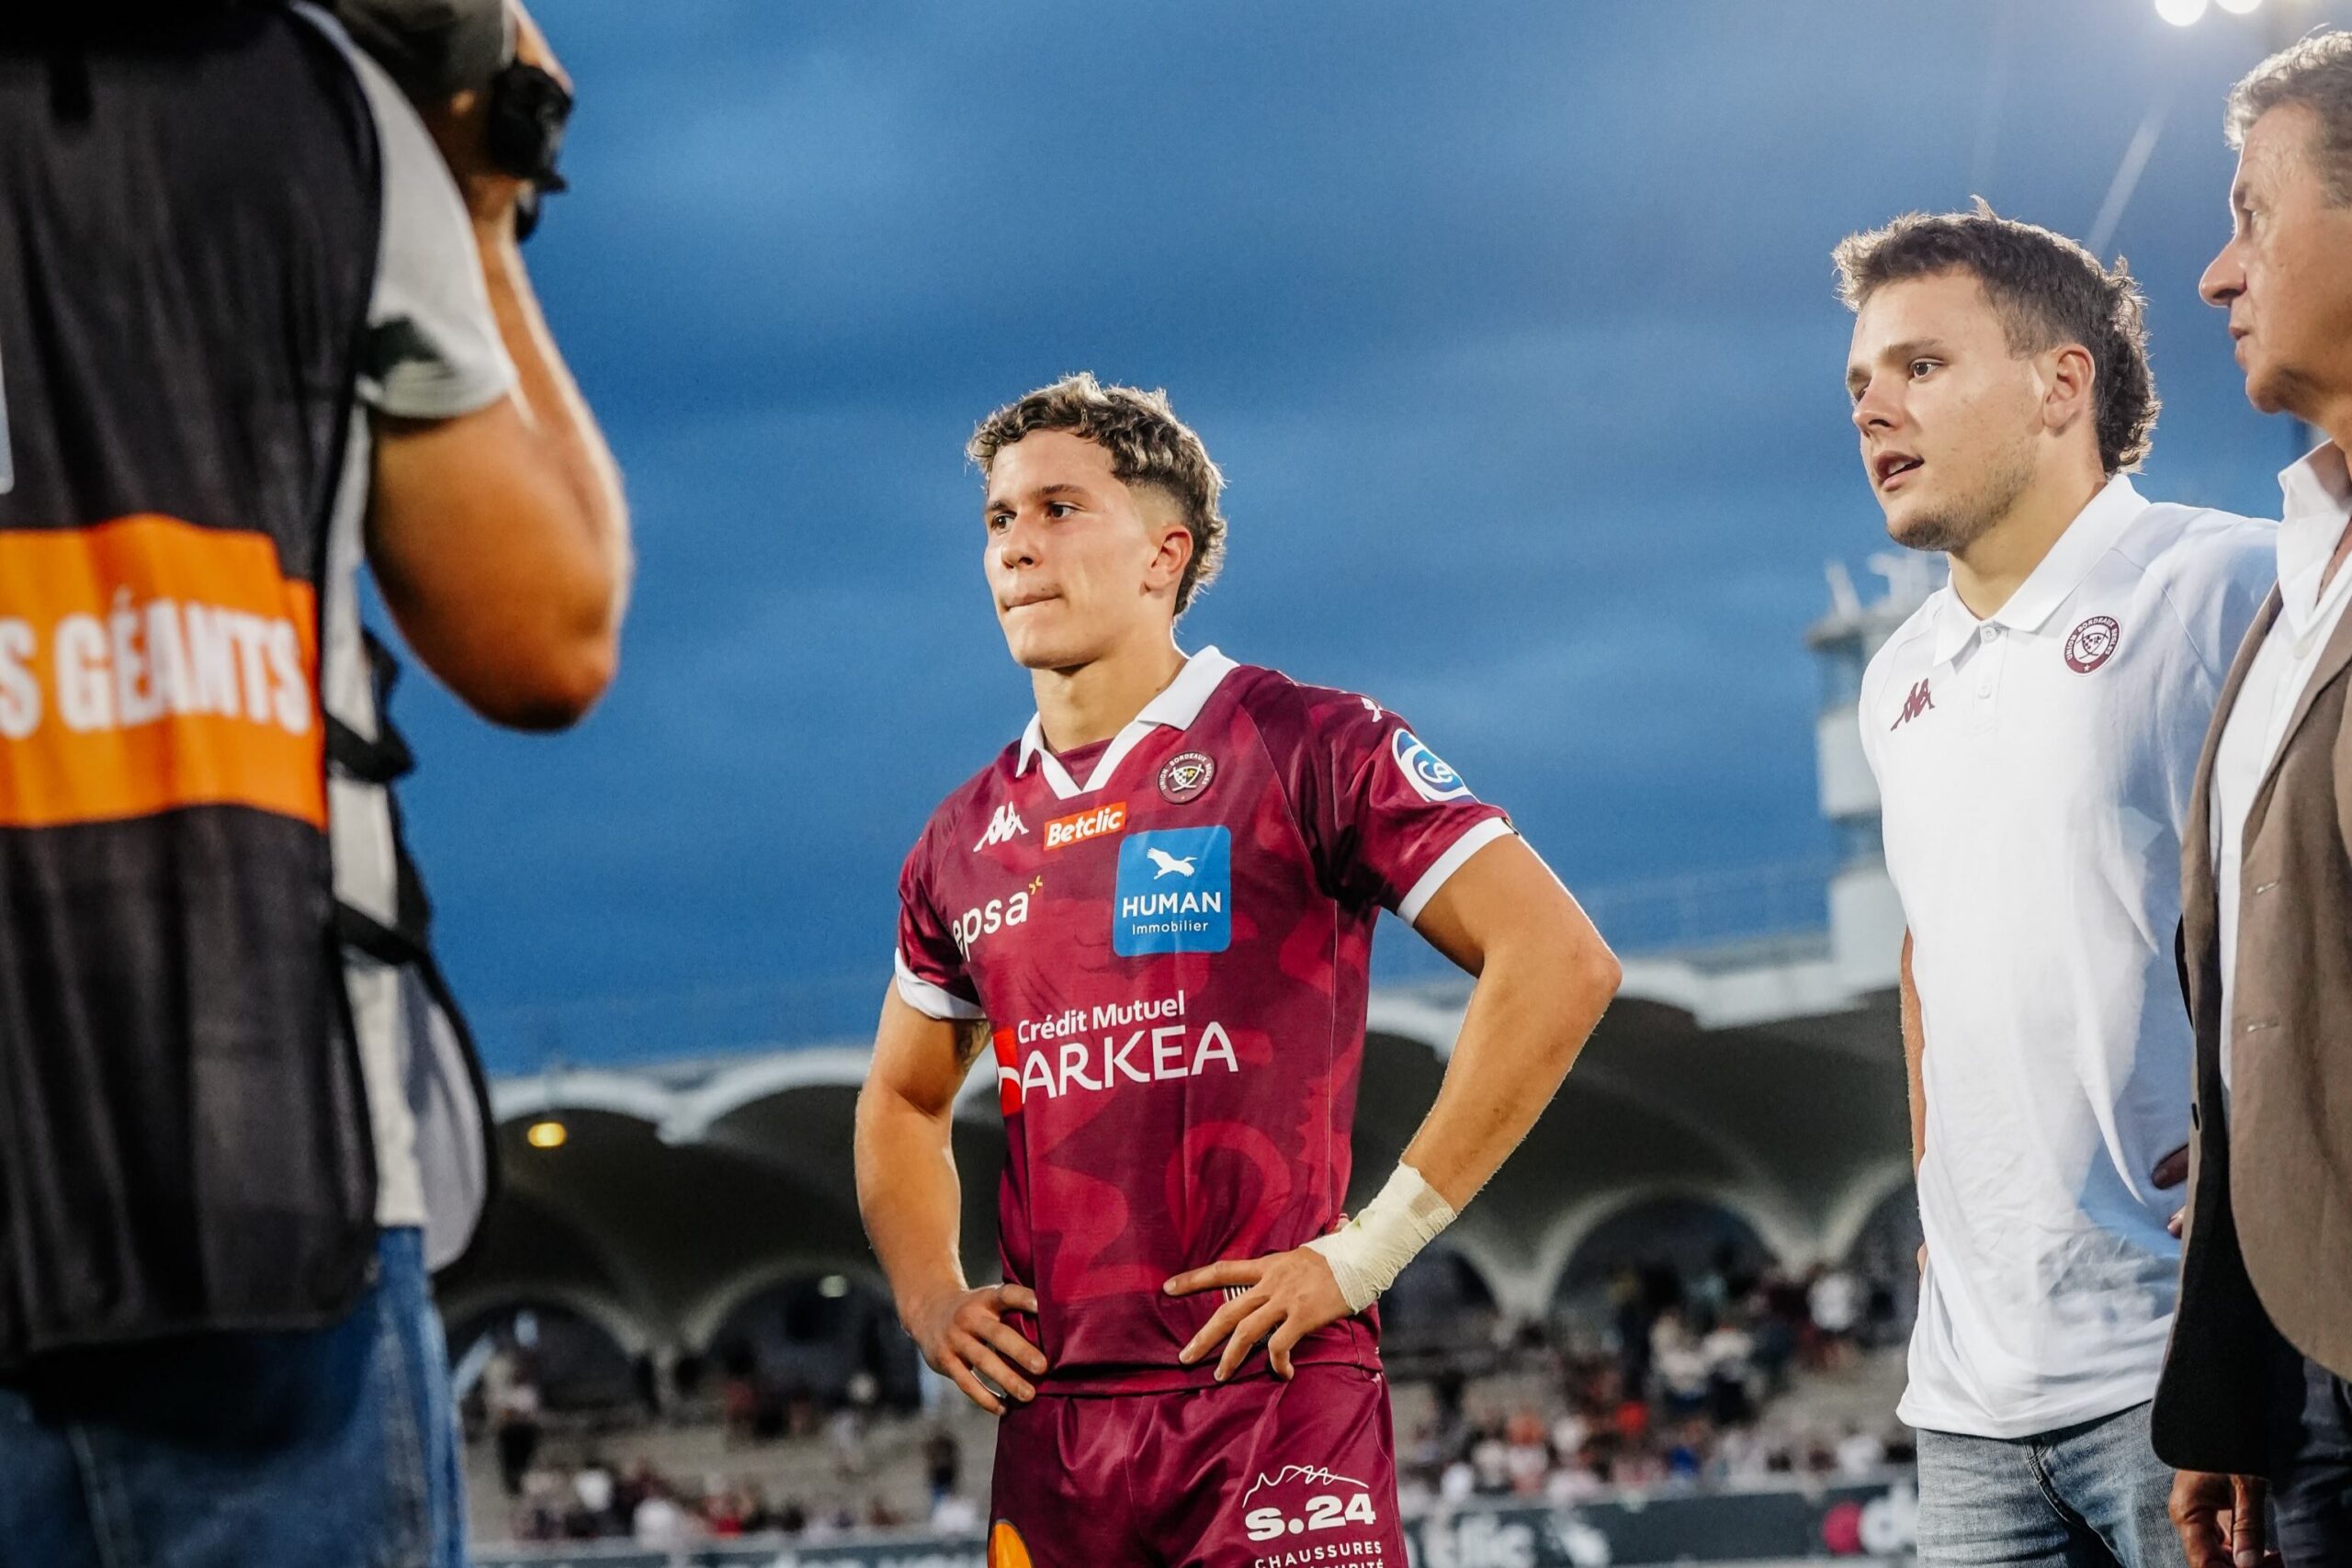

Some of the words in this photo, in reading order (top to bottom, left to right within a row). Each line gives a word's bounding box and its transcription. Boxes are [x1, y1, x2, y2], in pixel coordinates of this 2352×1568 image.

[2066, 635, 2077, 660] UNION
[2077, 617, 2116, 633] BORDEAUX
[1170, 753, 1207, 766] BORDEAUX
[1046, 807, 1123, 847] Betclic
[1122, 891, 1221, 919] HUMAN
[953, 891, 1029, 962] epsa
[1132, 919, 1209, 935] Immobilier
[1017, 1010, 1088, 1044] Crédit
[1092, 989, 1185, 1030] Mutuel
[1021, 1021, 1239, 1105] ARKEA
[1245, 1493, 1377, 1541] S.24
[1254, 1540, 1383, 1568] CHAUSSURES
